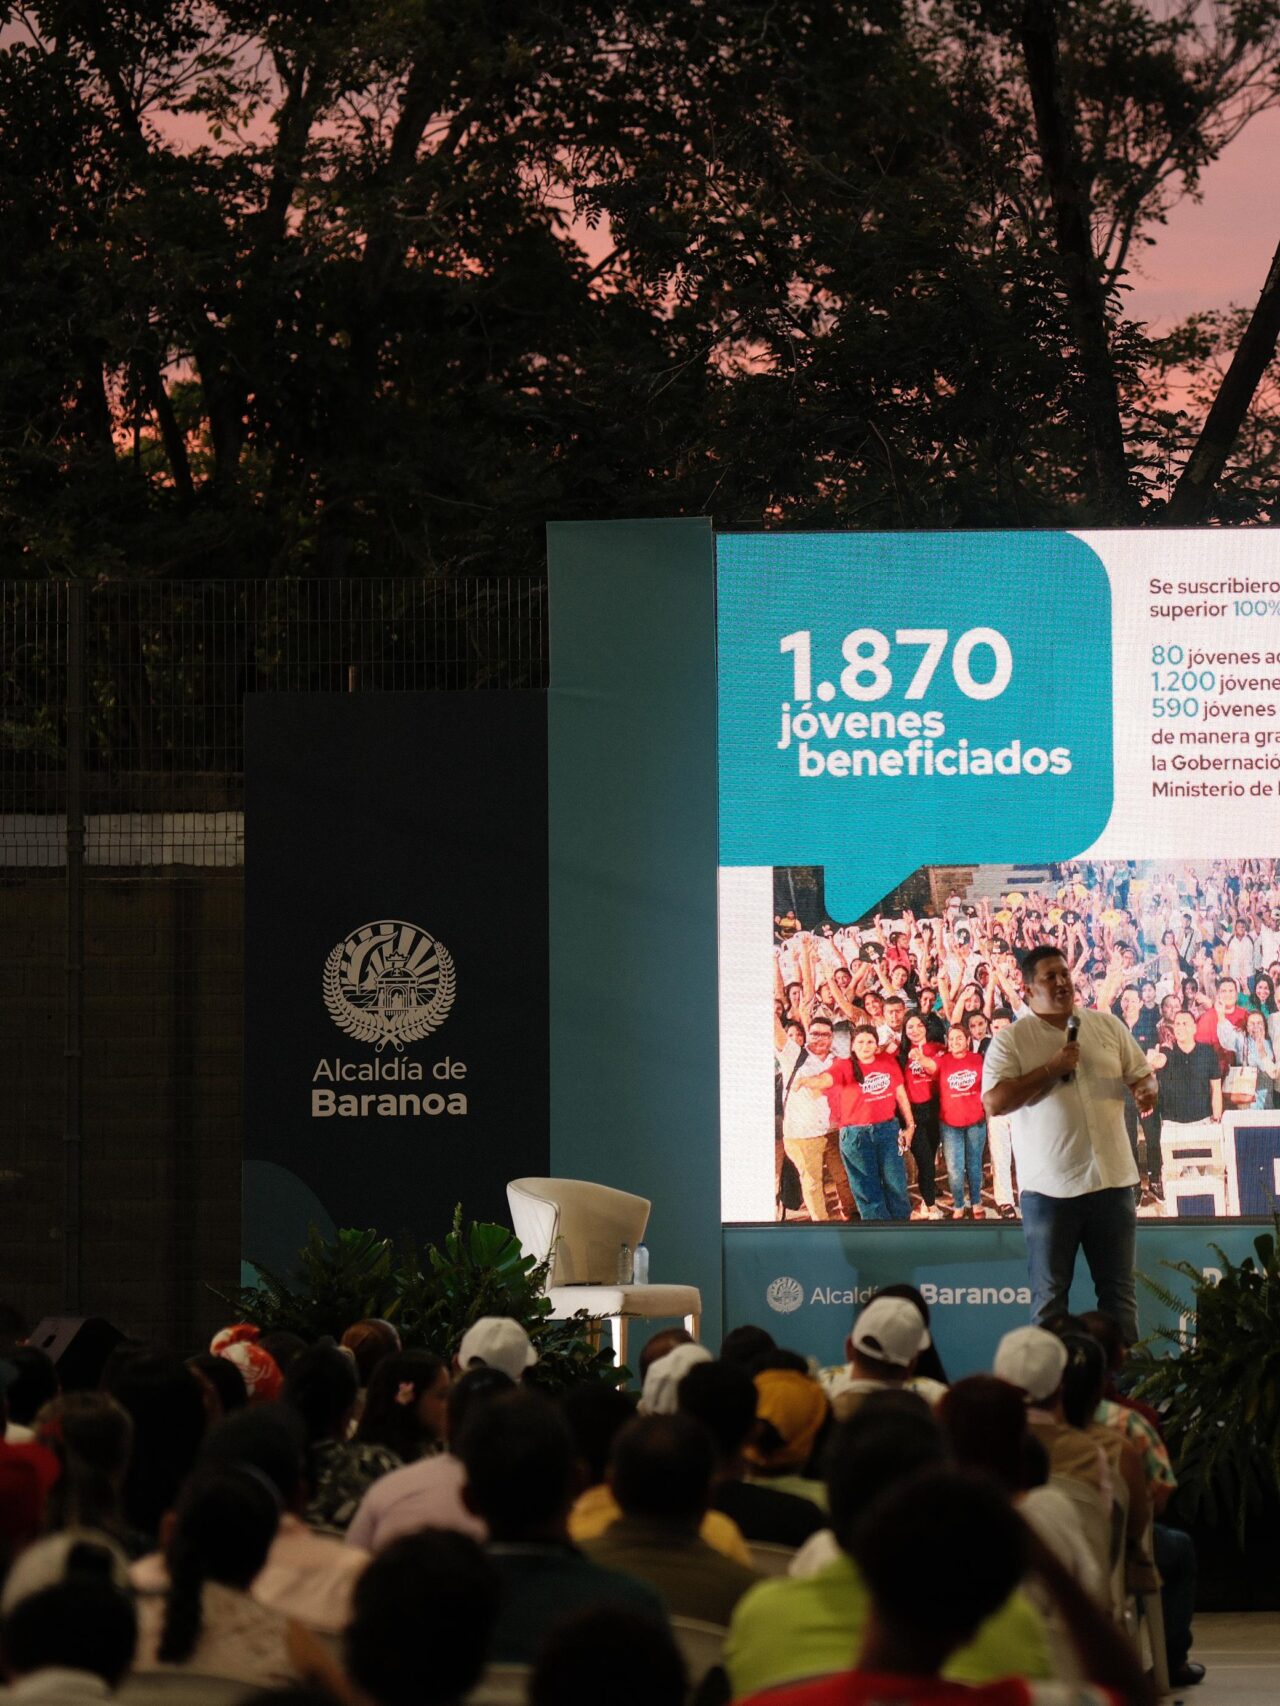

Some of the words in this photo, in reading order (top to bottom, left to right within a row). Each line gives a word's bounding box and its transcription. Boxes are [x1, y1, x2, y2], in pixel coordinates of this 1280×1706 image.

[1150, 579, 1173, 594] Se
[1150, 601, 1228, 621] superior
[780, 627, 1013, 702] 1.870
[1152, 645, 1184, 665] 80
[1187, 649, 1261, 669] jóvenes
[1152, 671, 1215, 692] 1.200
[1153, 697, 1199, 718] 590
[1203, 701, 1276, 721] jóvenes
[777, 702, 946, 750] jóvenes
[1152, 729, 1175, 744] de
[1180, 732, 1249, 744] manera
[799, 738, 1072, 777] beneficiados
[1152, 755, 1166, 771] la
[1153, 781, 1245, 797] Ministerio
[1250, 781, 1273, 796] de
[312, 1056, 423, 1082] Alcaldía
[432, 1056, 468, 1080] de
[311, 1089, 468, 1117] Baranoa
[919, 1283, 1032, 1305] Baranoa
